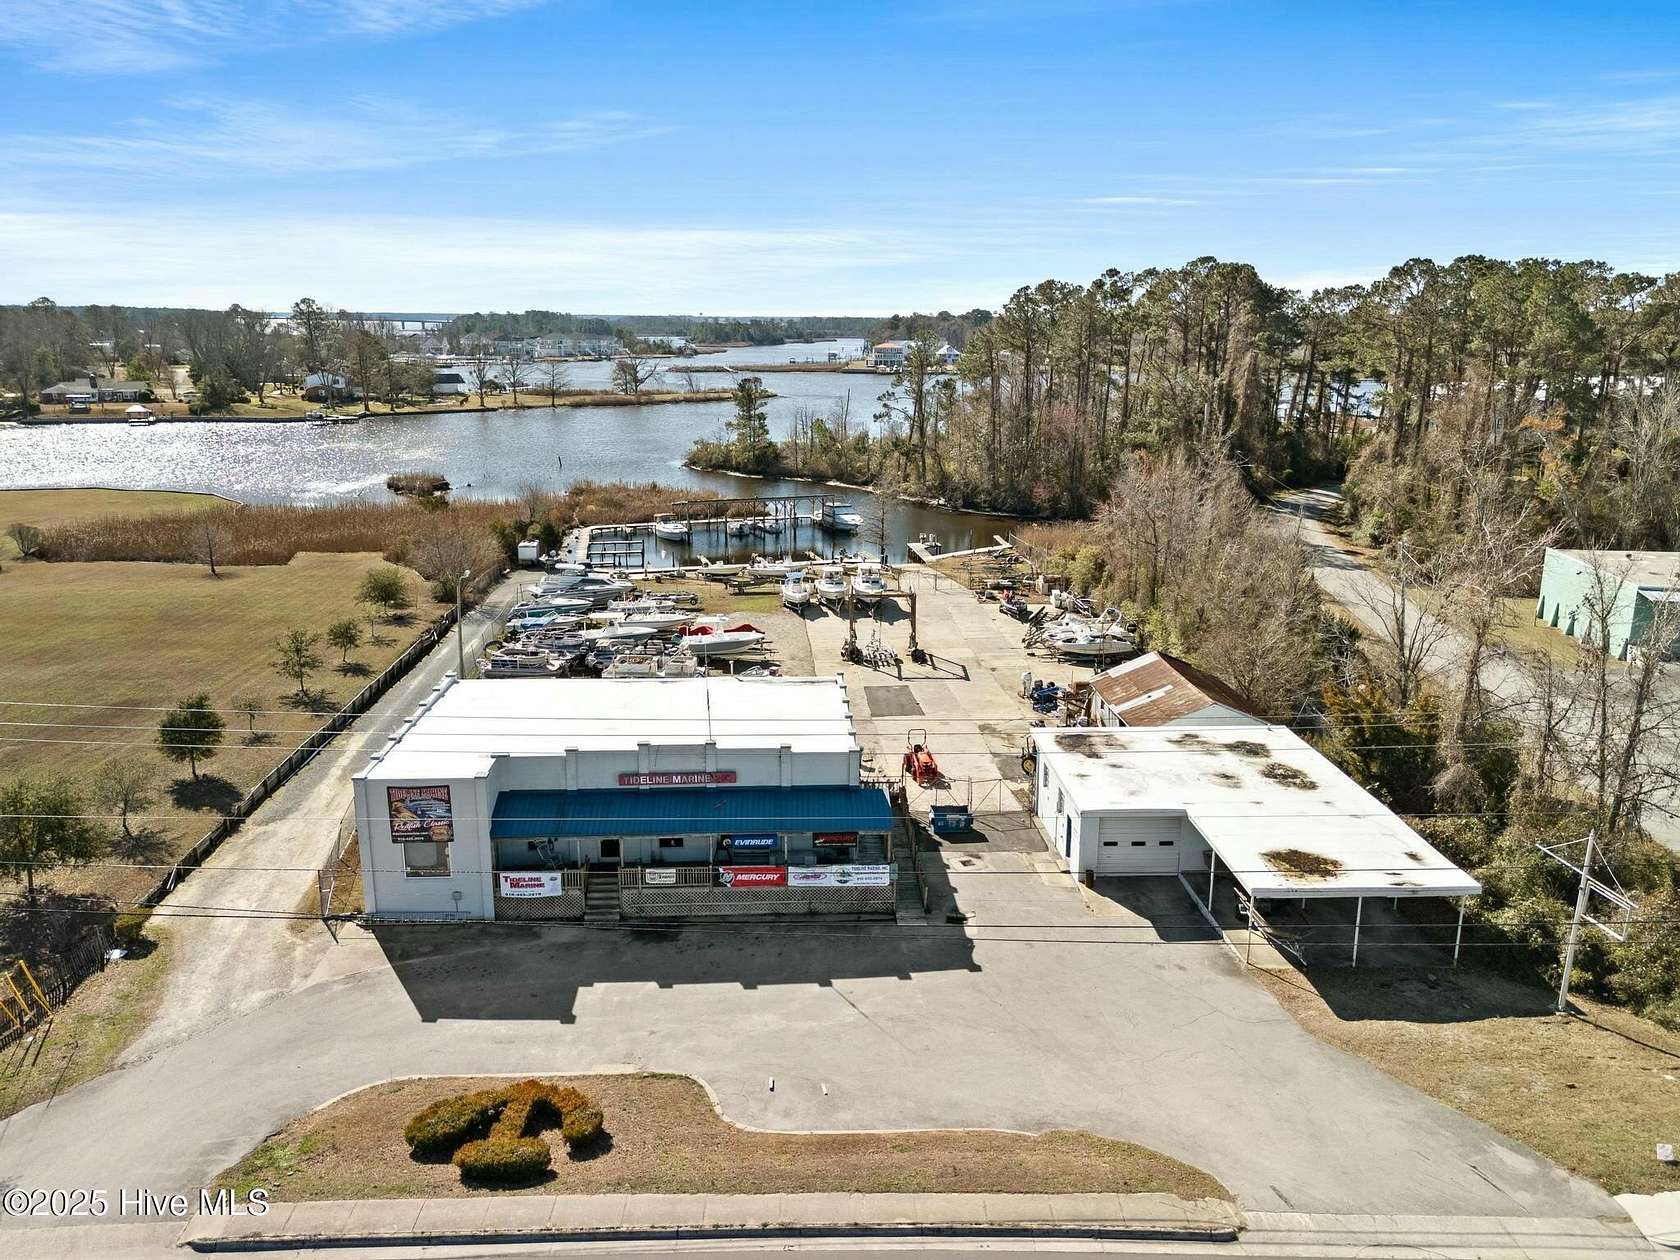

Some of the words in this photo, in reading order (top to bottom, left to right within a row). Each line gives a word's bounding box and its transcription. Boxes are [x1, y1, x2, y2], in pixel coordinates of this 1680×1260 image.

[623, 775, 669, 785] TIDELINE
[672, 774, 711, 784] MARINE
[736, 873, 780, 881] MERCURY
